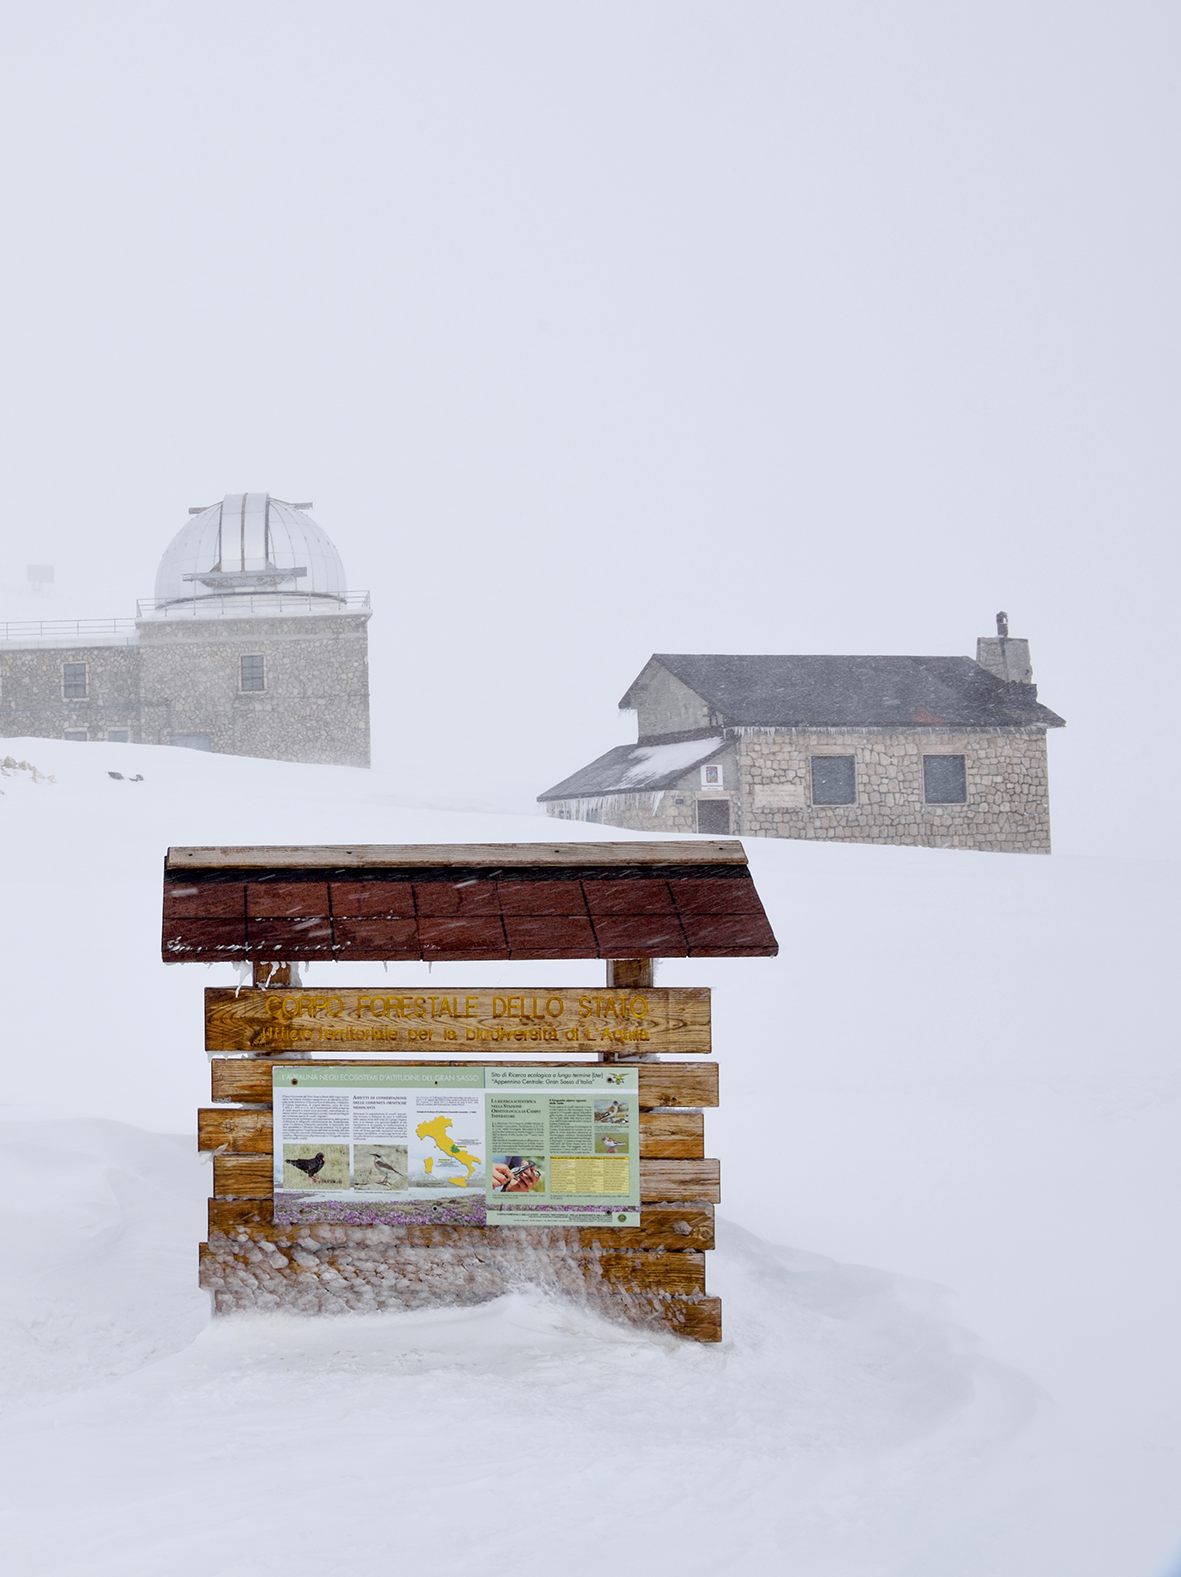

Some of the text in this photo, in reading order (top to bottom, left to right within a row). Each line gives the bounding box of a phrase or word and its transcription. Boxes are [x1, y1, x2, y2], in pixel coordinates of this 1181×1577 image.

[265, 995, 649, 1018] CORPO FORESTALE DELLO STATO
[263, 1026, 650, 1044] Ufficio territoriale per la biodiversità di L'Aquila
[434, 1074, 455, 1082] GRAN
